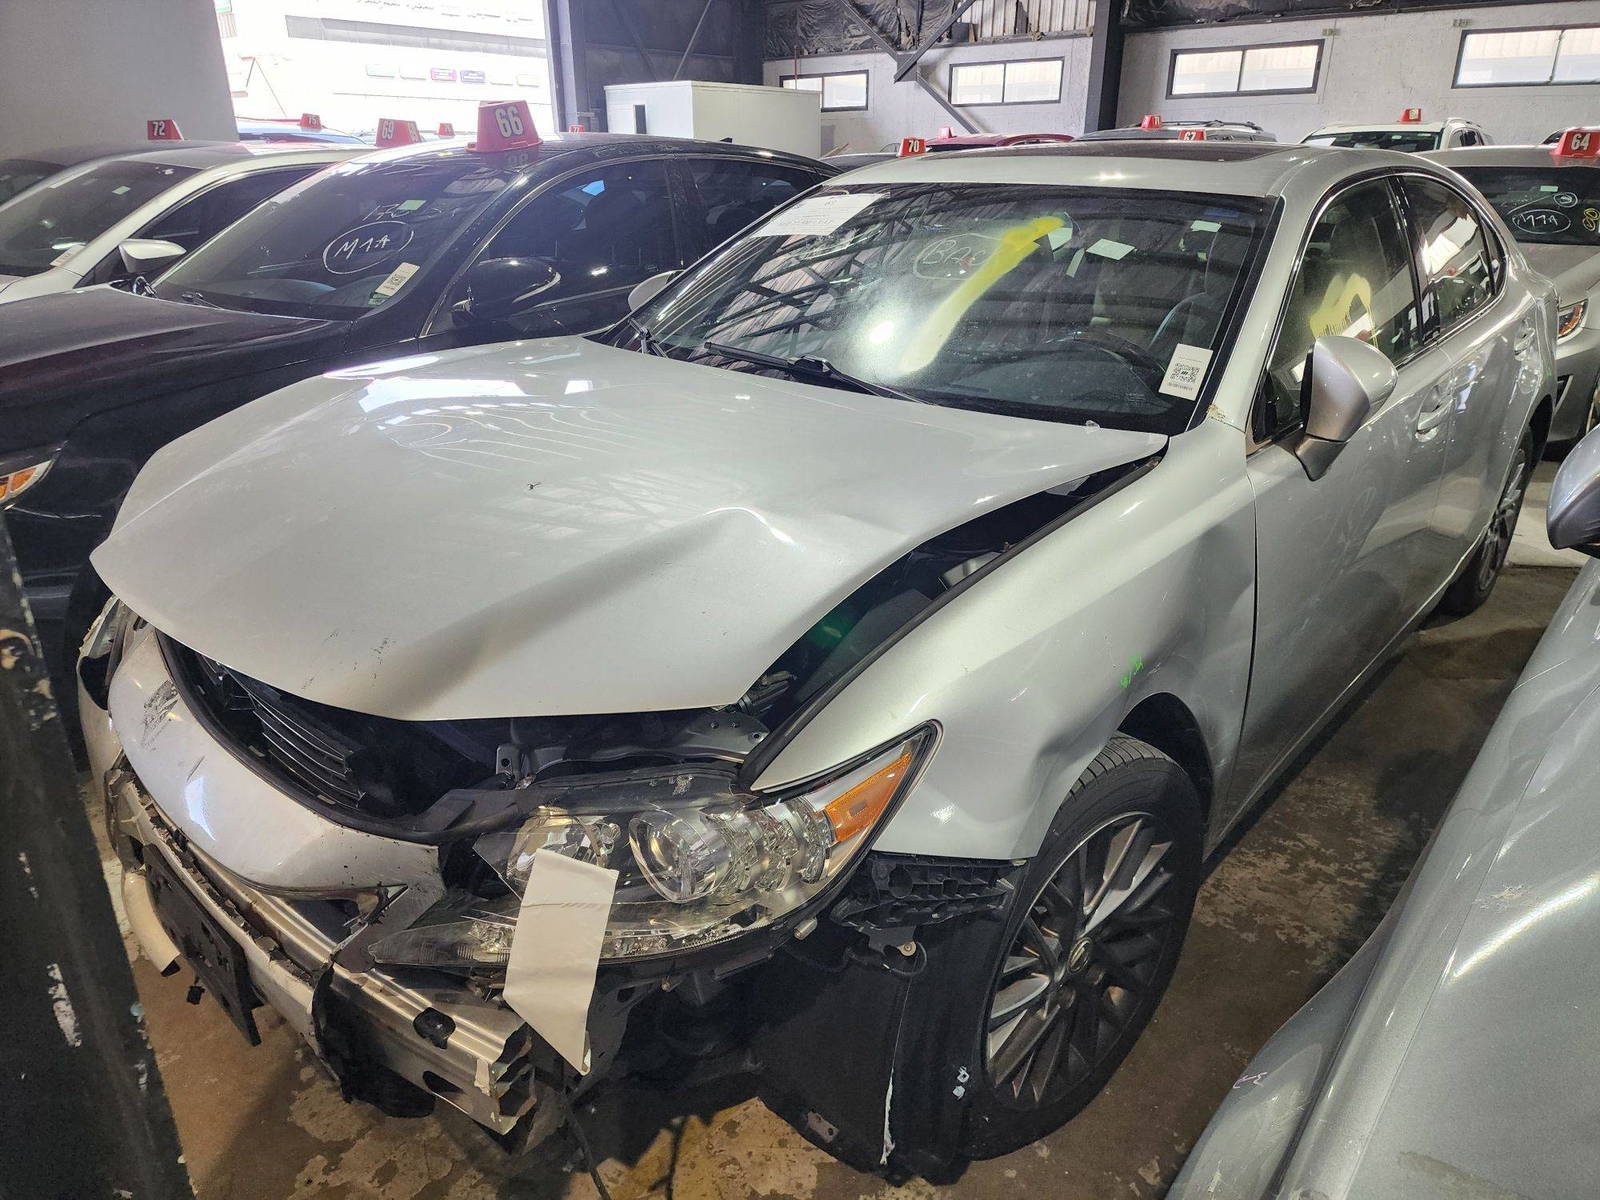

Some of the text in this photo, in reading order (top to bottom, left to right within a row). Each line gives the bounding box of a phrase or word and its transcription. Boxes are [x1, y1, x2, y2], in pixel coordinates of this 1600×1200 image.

[152, 121, 166, 136] 72
[382, 120, 394, 140] 69
[496, 106, 523, 138] 66
[908, 140, 920, 152] 70
[1571, 133, 1591, 151] 64
